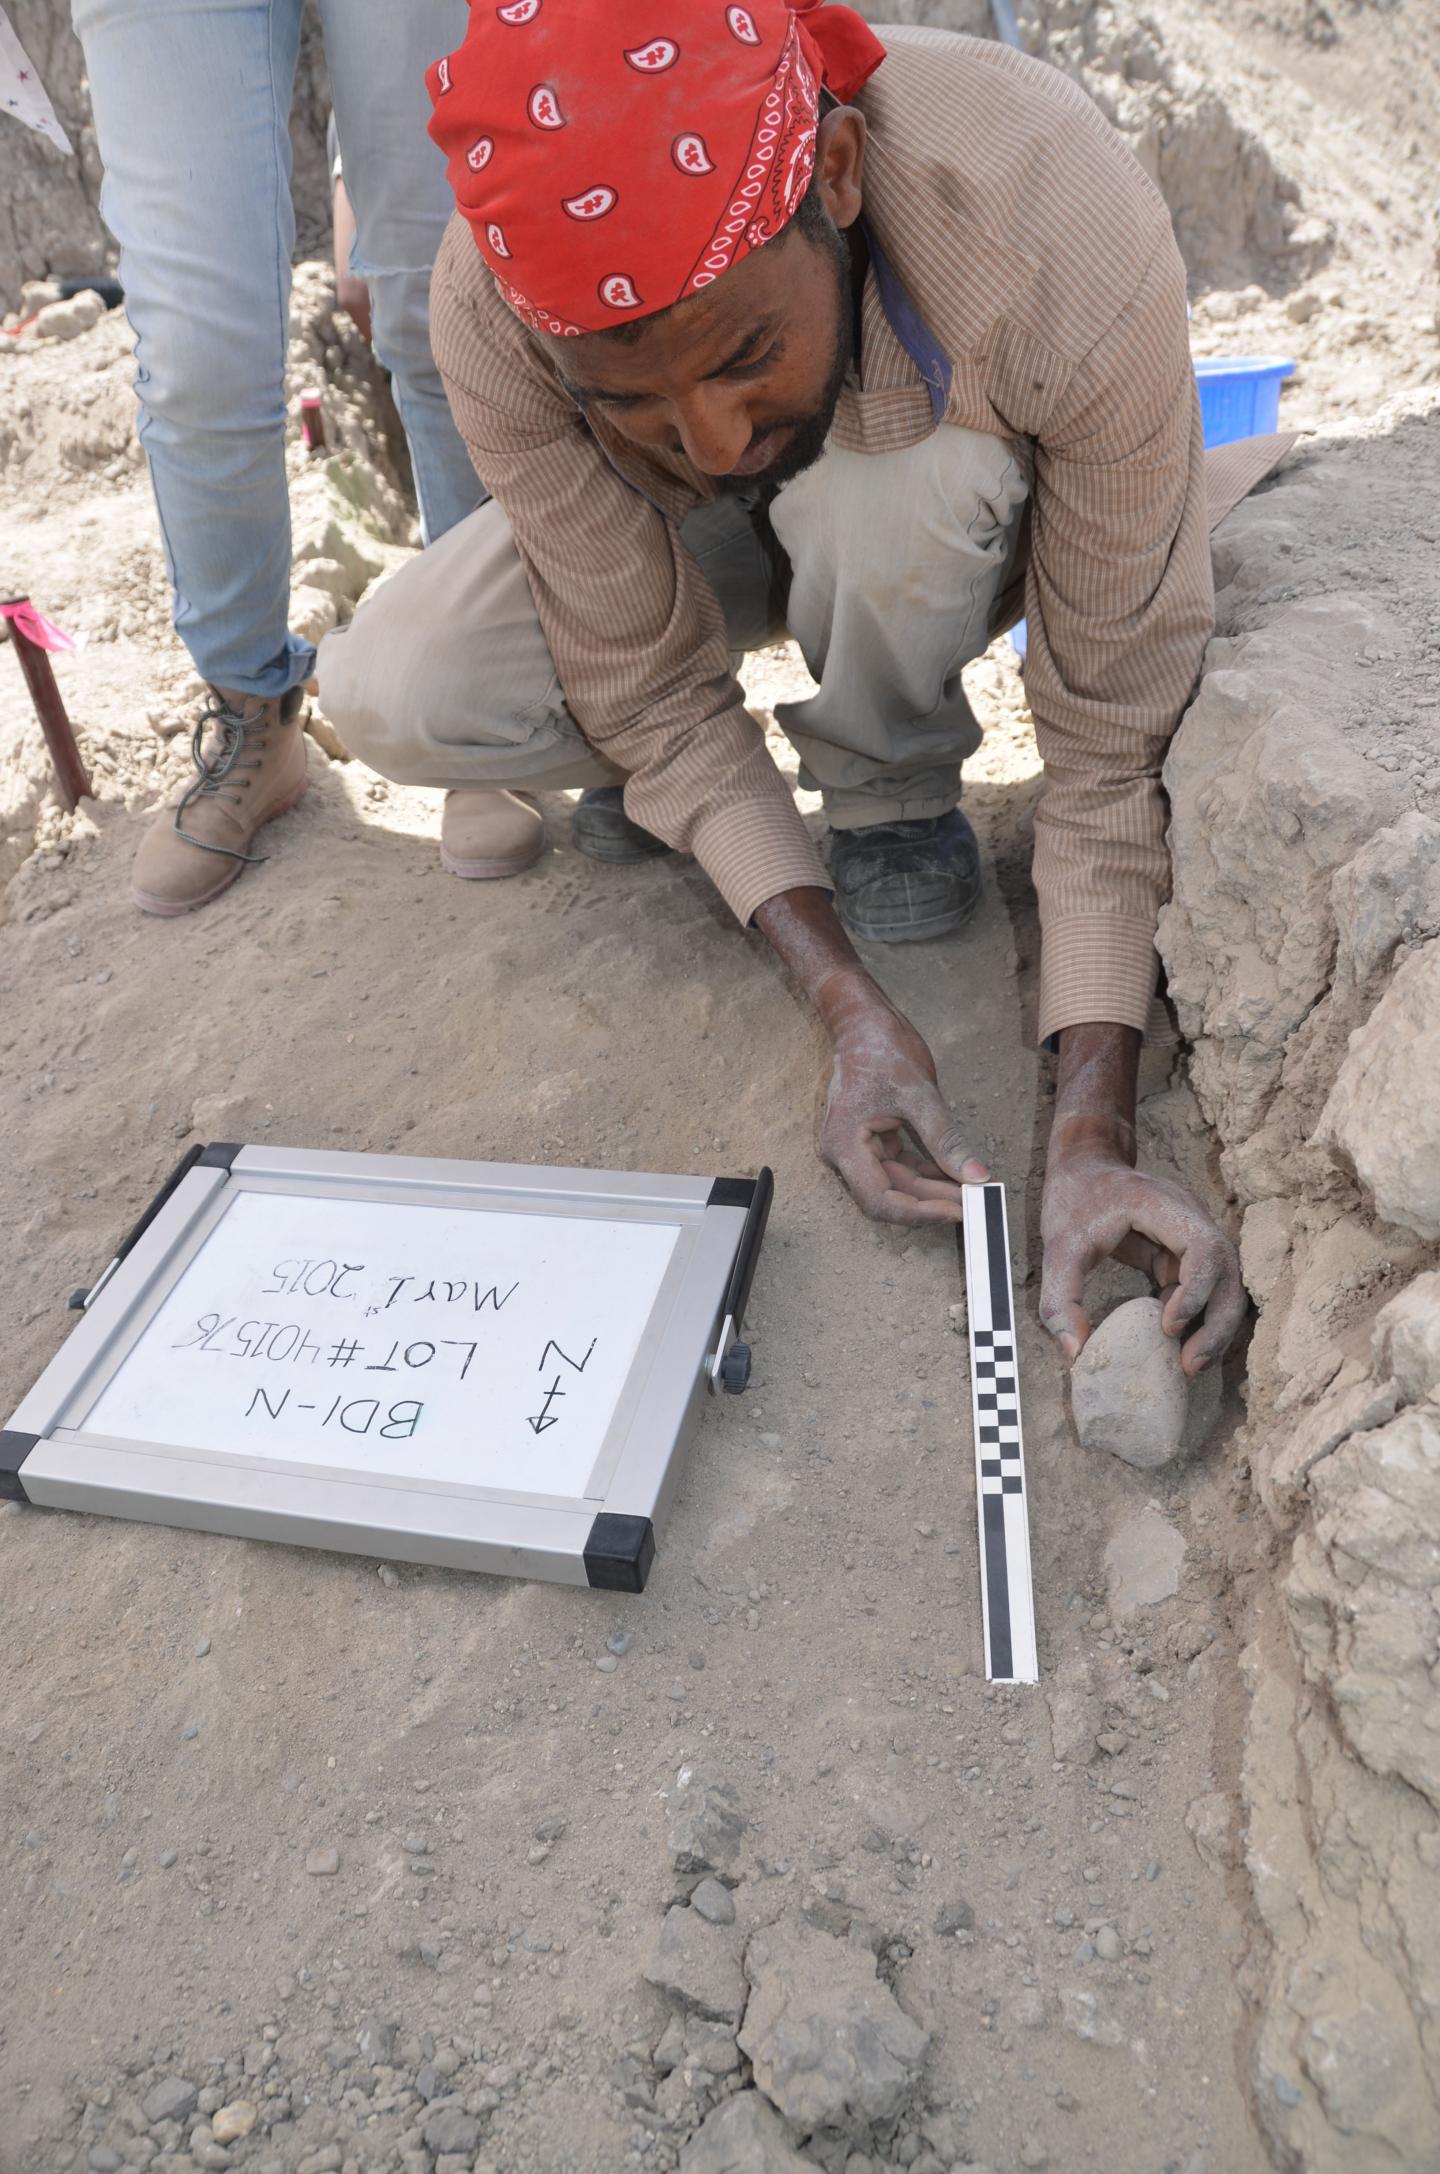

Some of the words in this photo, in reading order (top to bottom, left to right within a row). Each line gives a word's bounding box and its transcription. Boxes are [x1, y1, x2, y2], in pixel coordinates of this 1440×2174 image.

[261, 1259, 365, 1298] 2015
[364, 1340, 478, 1380] LOT
[538, 1337, 598, 1372] N
